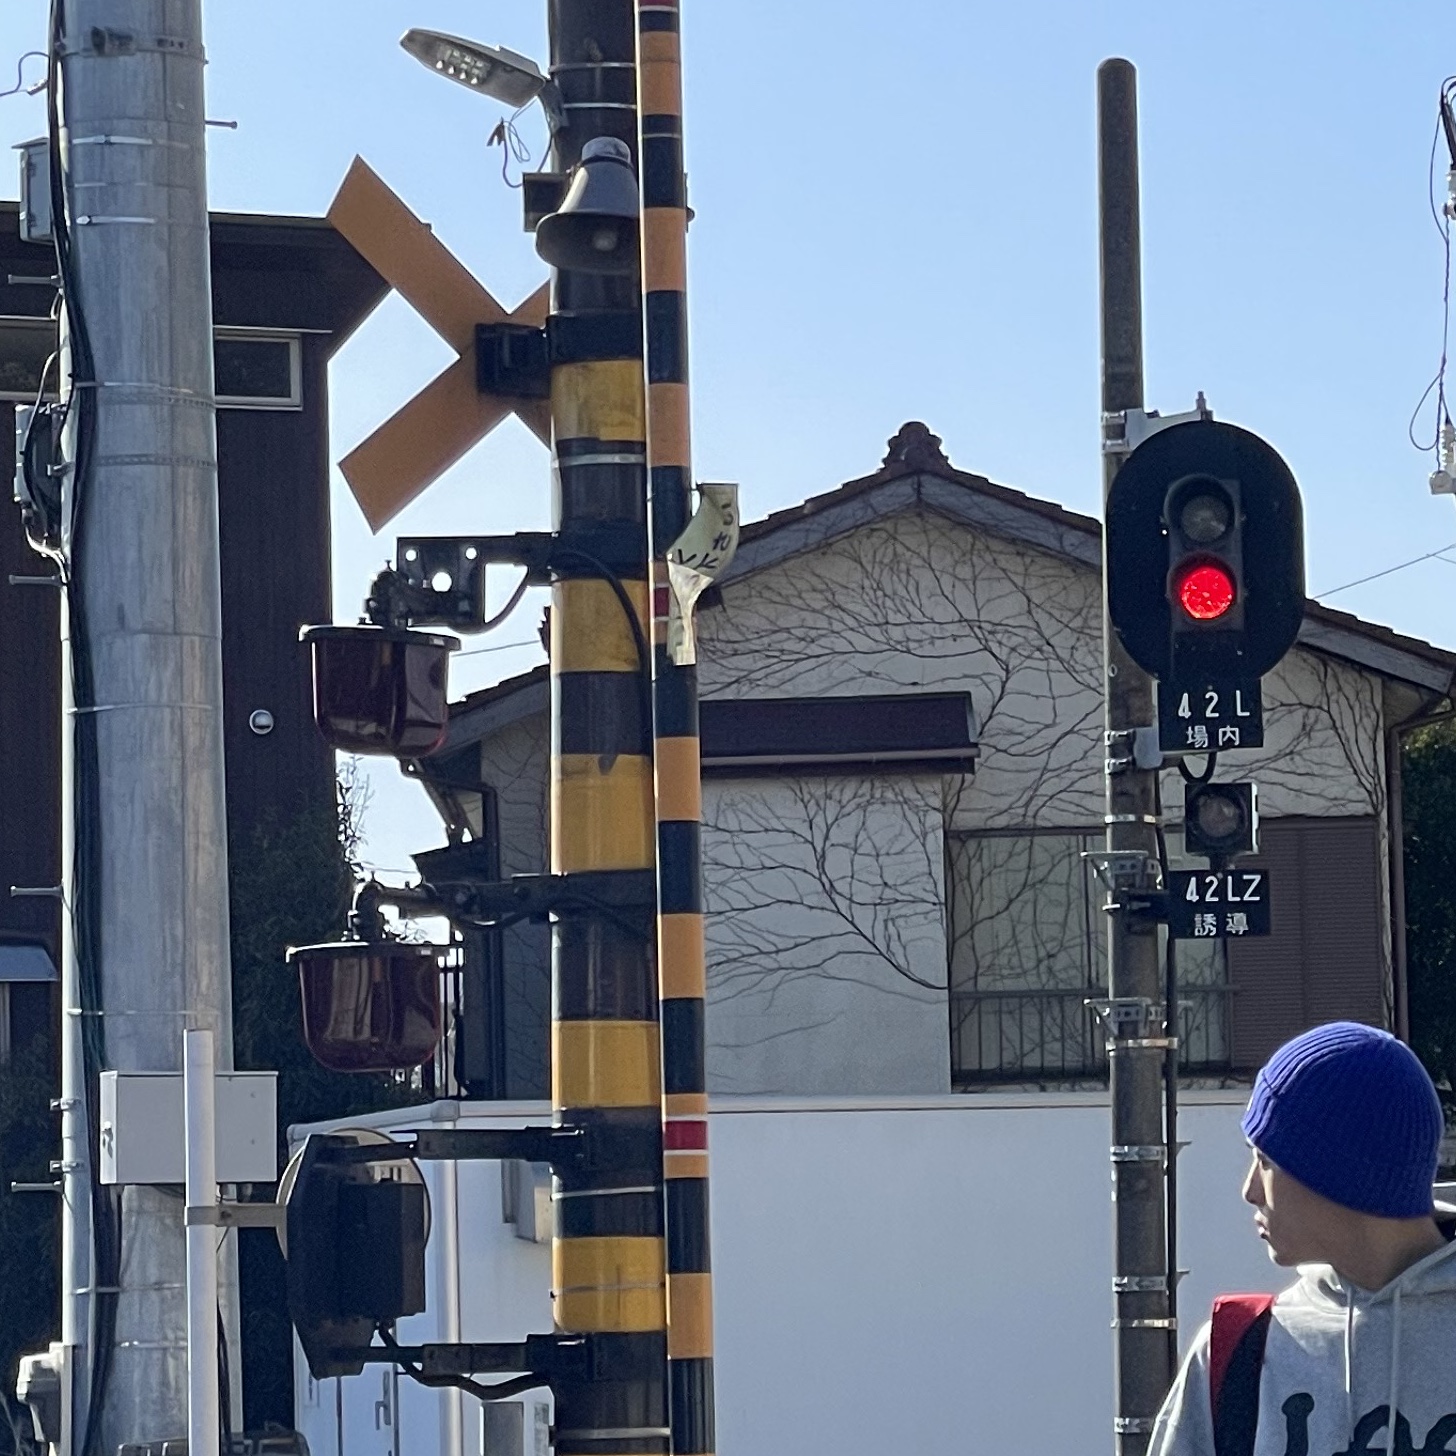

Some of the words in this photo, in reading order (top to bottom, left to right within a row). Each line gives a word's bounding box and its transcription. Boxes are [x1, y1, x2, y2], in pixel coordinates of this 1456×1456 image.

[1177, 689, 1251, 719] 42L
[1185, 724, 1241, 748] 場内
[1185, 874, 1262, 903] 42LZ
[1193, 912, 1250, 937] 誘導
